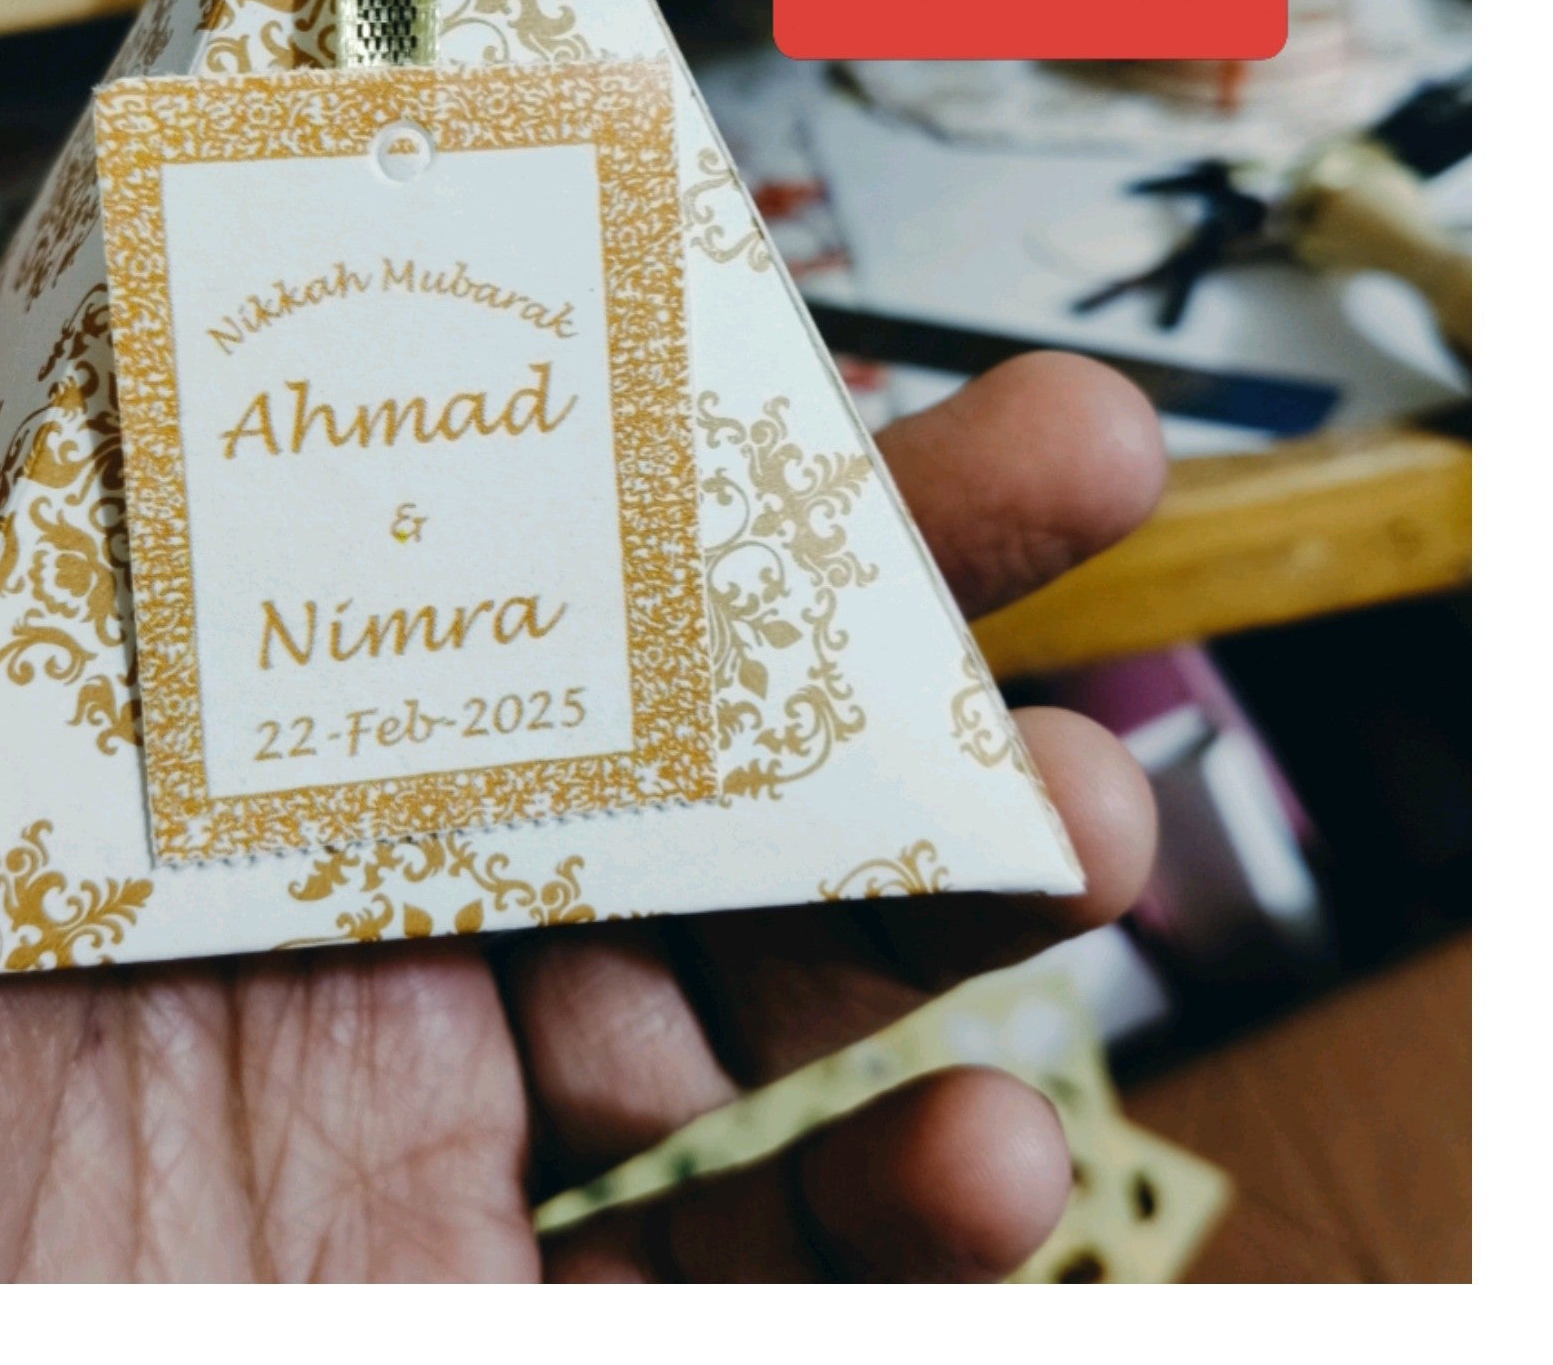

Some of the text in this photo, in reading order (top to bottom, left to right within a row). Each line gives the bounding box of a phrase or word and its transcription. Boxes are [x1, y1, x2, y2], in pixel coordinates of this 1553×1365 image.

[206, 258, 579, 355] Nikkah Mubarak
[220, 361, 579, 459] Ahmad
[389, 502, 428, 544] &
[258, 595, 567, 670] Nimra
[254, 686, 587, 762] 22-Feb-2025
